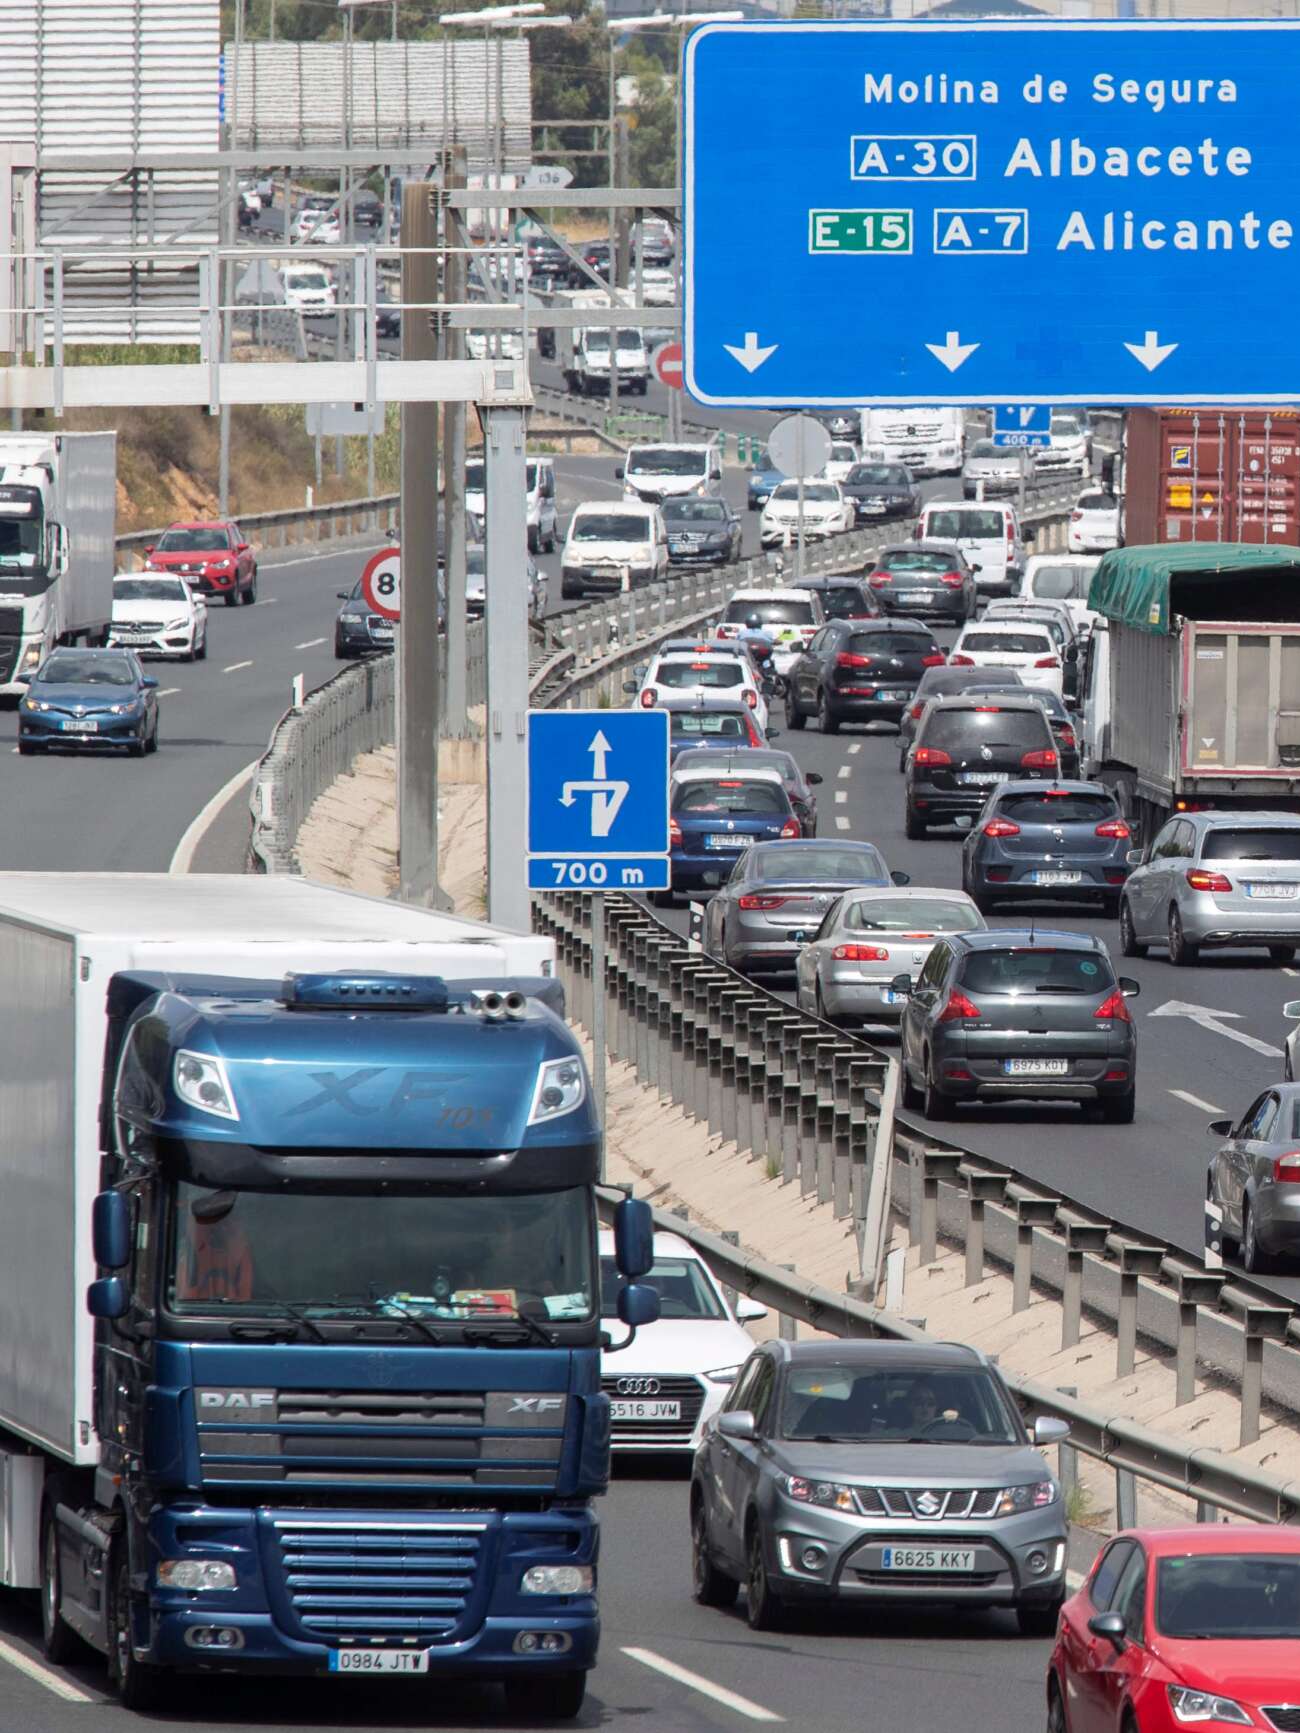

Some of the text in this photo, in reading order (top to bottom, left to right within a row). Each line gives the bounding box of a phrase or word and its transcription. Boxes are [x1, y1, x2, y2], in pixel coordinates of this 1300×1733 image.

[864, 73, 1237, 113] Molina de Segura
[858, 137, 1252, 177] A-30 Albacete
[815, 210, 1294, 250] E-15 A-7 Alicante
[1003, 434, 1028, 445] 400
[377, 572, 401, 596] 8
[551, 861, 644, 885] 700 m
[1013, 1059, 1042, 1072] 6975
[280, 1066, 470, 1118] XF
[200, 1392, 563, 1413] DAF XF
[650, 1403, 678, 1417] JVM
[894, 1551, 971, 1569] 6625 KKY
[340, 1652, 422, 1671] 0984 JTW
